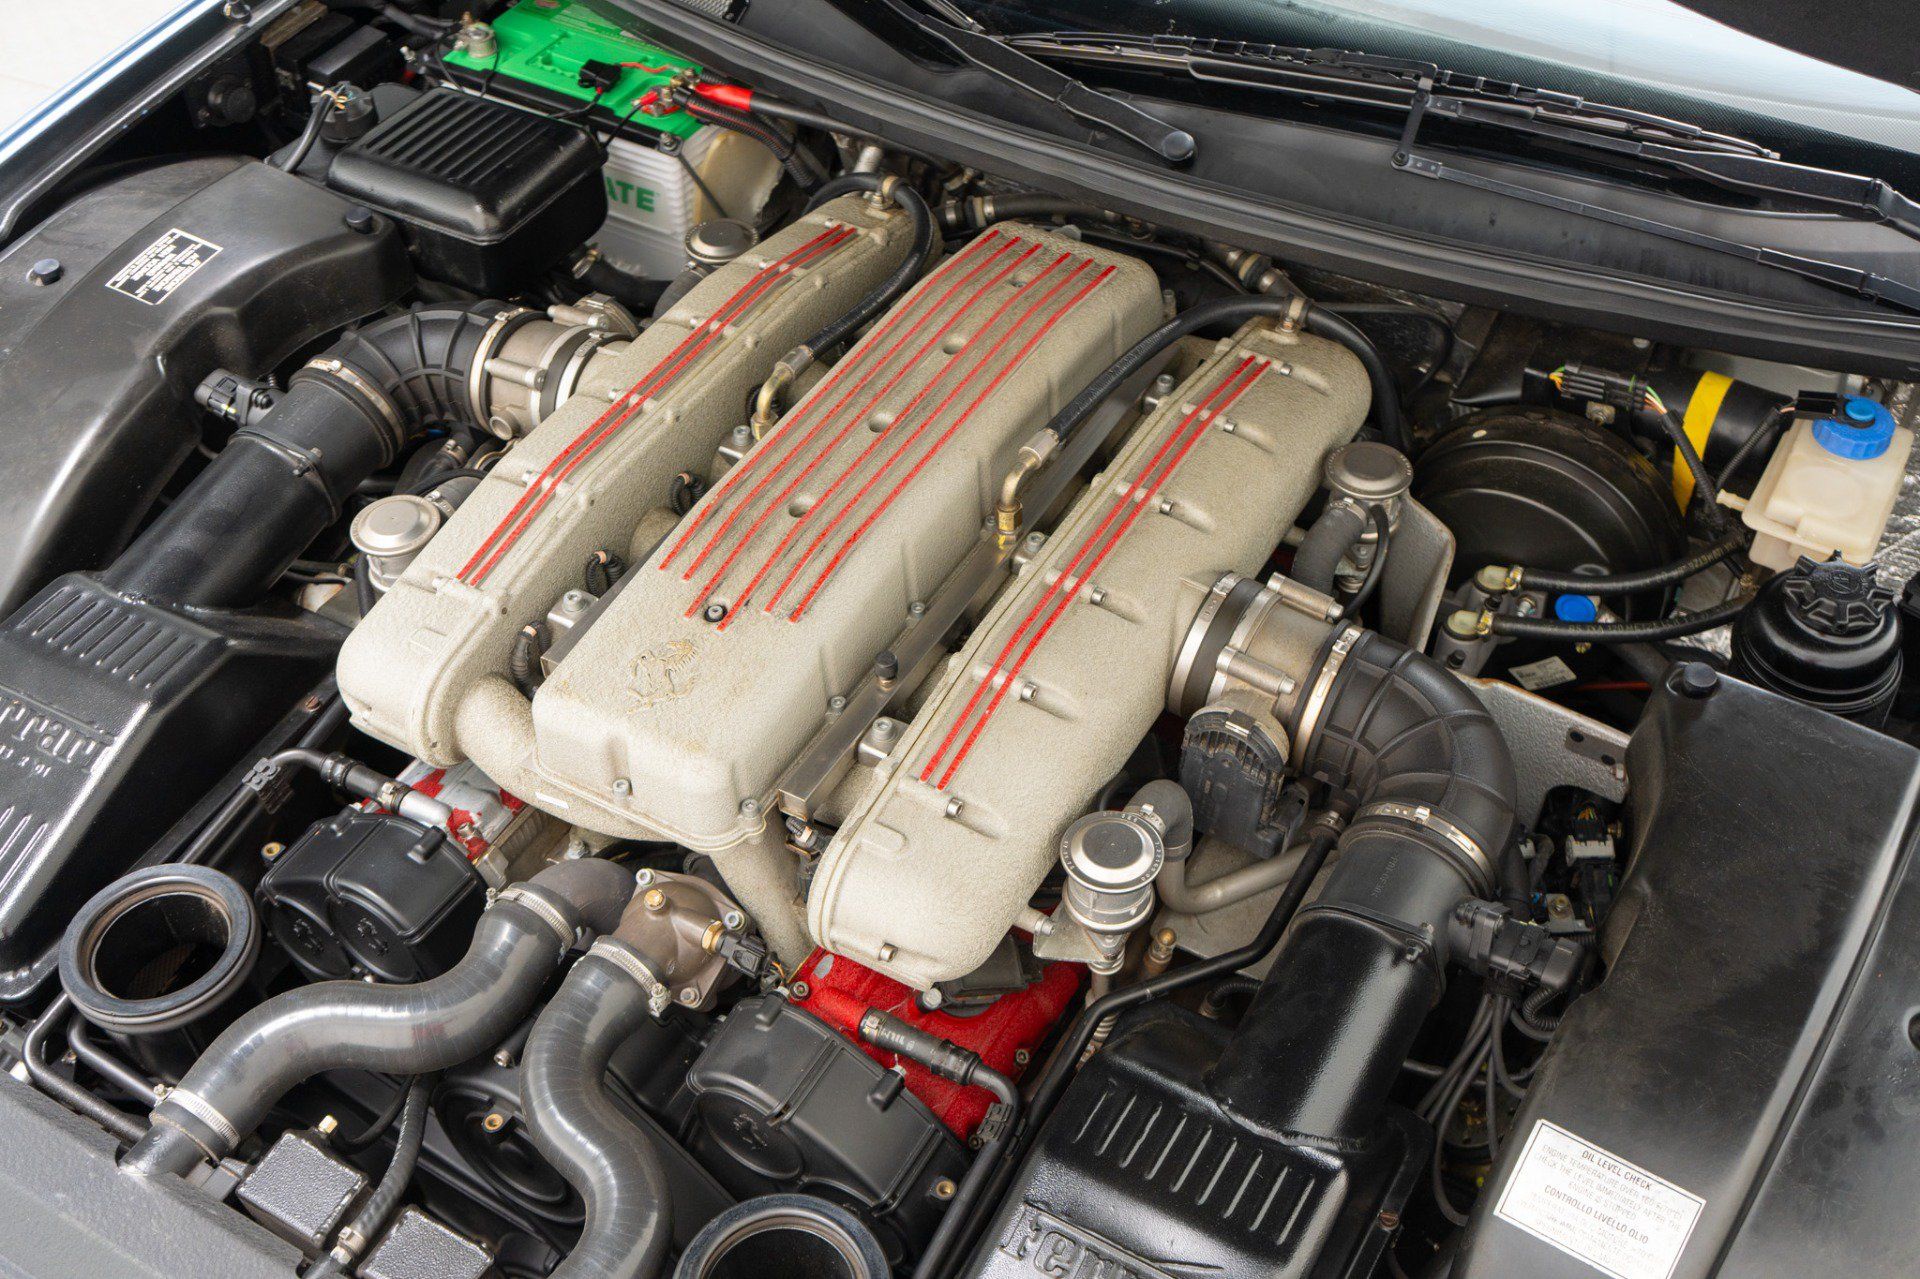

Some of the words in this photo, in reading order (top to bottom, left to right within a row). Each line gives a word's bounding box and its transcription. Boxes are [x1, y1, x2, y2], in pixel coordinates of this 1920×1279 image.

[1582, 1150, 1596, 1163] OIL
[1597, 1158, 1621, 1177] LEVEL
[1624, 1171, 1652, 1191] CHECK
[1544, 1184, 1593, 1216] CONTROLLO
[1593, 1209, 1628, 1234] LIVELLO
[1628, 1227, 1649, 1245] OLIO
